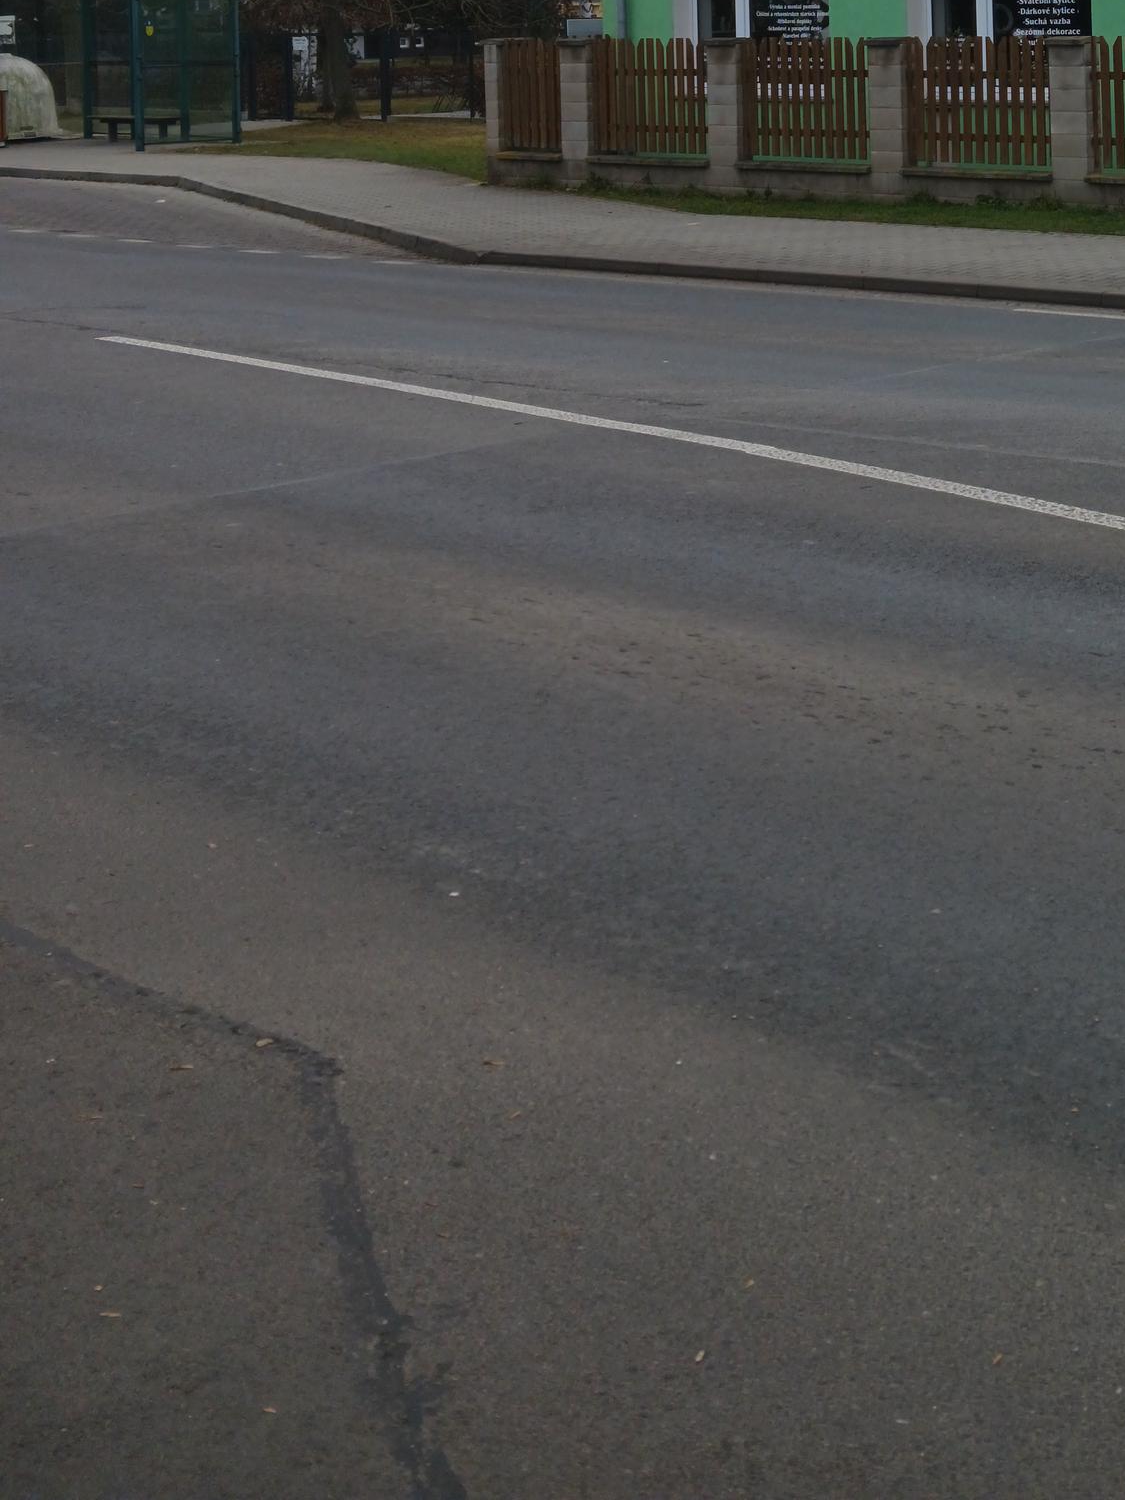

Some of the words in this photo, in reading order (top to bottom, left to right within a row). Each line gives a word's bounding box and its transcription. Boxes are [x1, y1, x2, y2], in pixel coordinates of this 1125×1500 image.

[1052, 6, 1076, 16] kytice
[1049, 17, 1071, 25] vazba
[1046, 28, 1081, 36] dekorace
